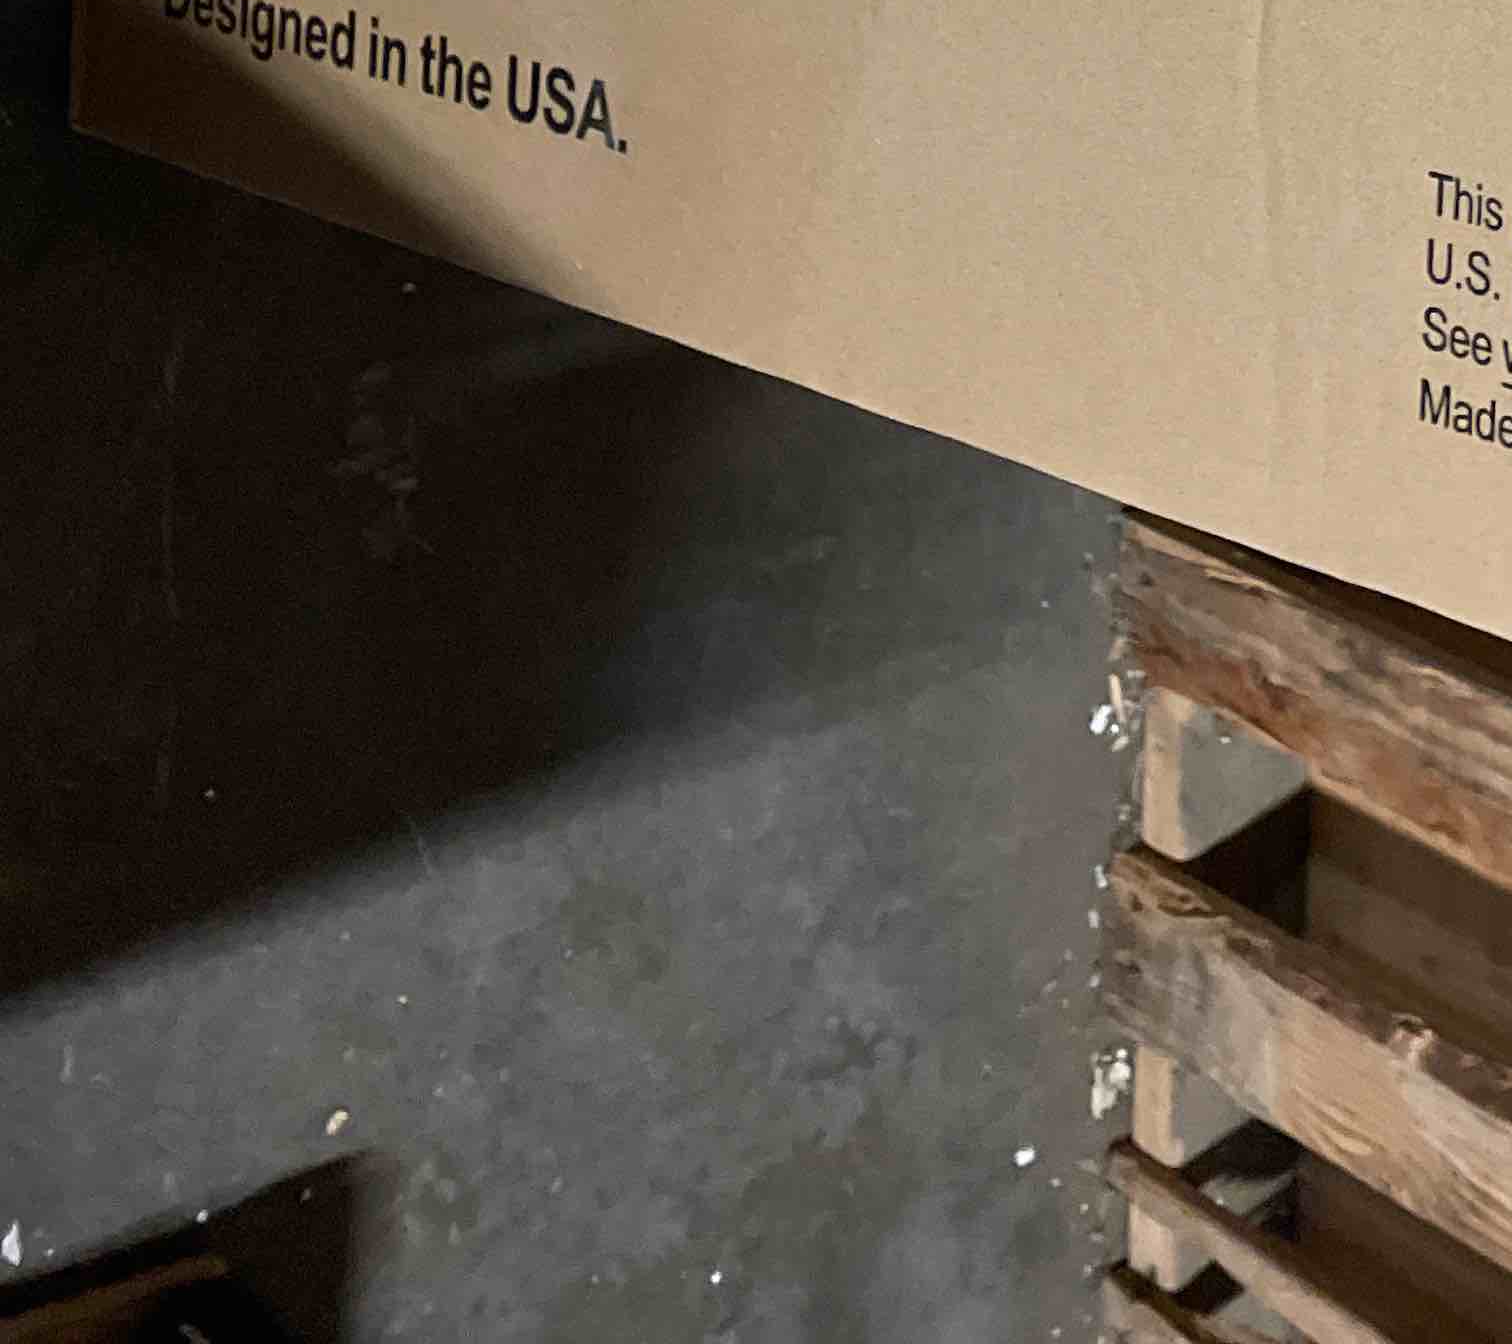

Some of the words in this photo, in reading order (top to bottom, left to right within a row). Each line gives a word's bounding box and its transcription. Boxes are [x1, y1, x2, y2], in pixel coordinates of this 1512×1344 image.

[369, 17, 406, 86] in
[421, 36, 491, 109] the
[508, 55, 627, 154] USA.
[1429, 171, 1502, 231] This
[1427, 238, 1499, 300] U.S.
[1422, 307, 1492, 365] See
